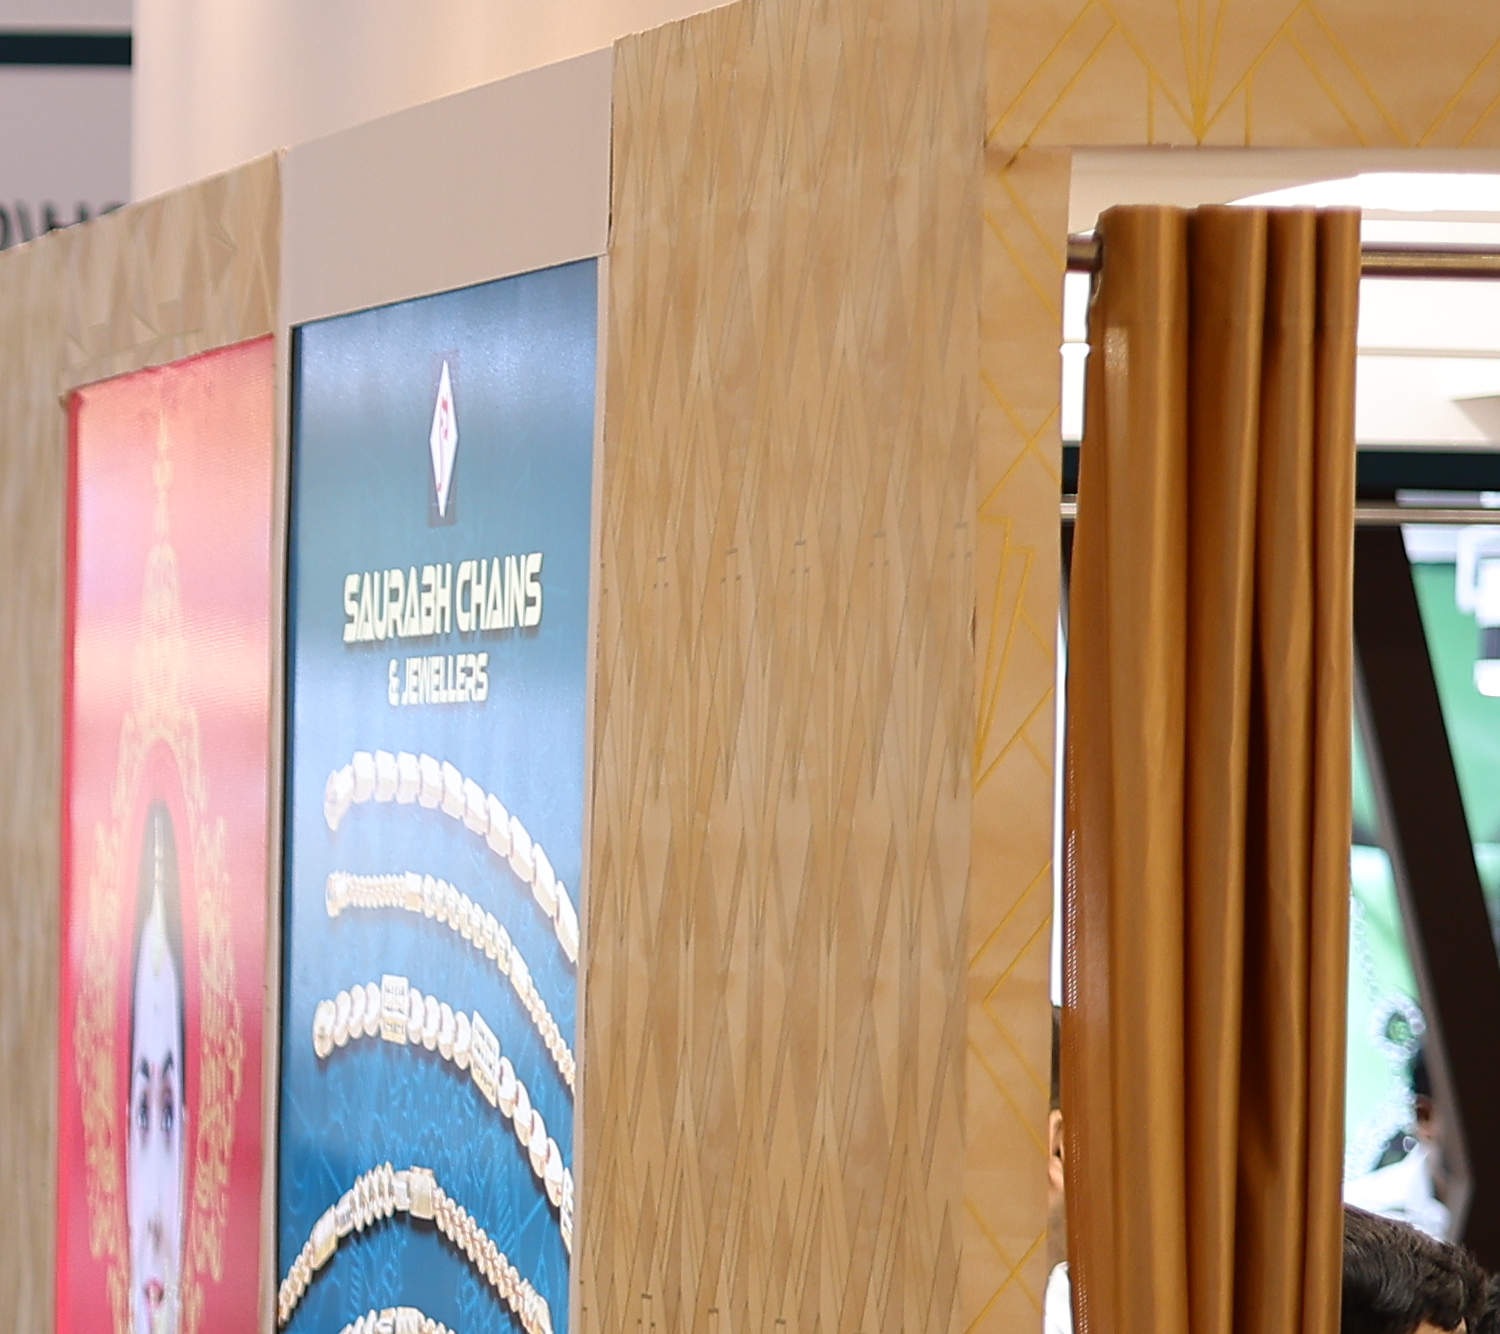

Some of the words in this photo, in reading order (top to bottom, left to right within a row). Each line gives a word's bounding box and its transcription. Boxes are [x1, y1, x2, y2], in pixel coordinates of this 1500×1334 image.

[343, 562, 452, 643] SAURABH
[455, 552, 543, 632] CHAINS
[401, 652, 489, 706] JEWELLERS
